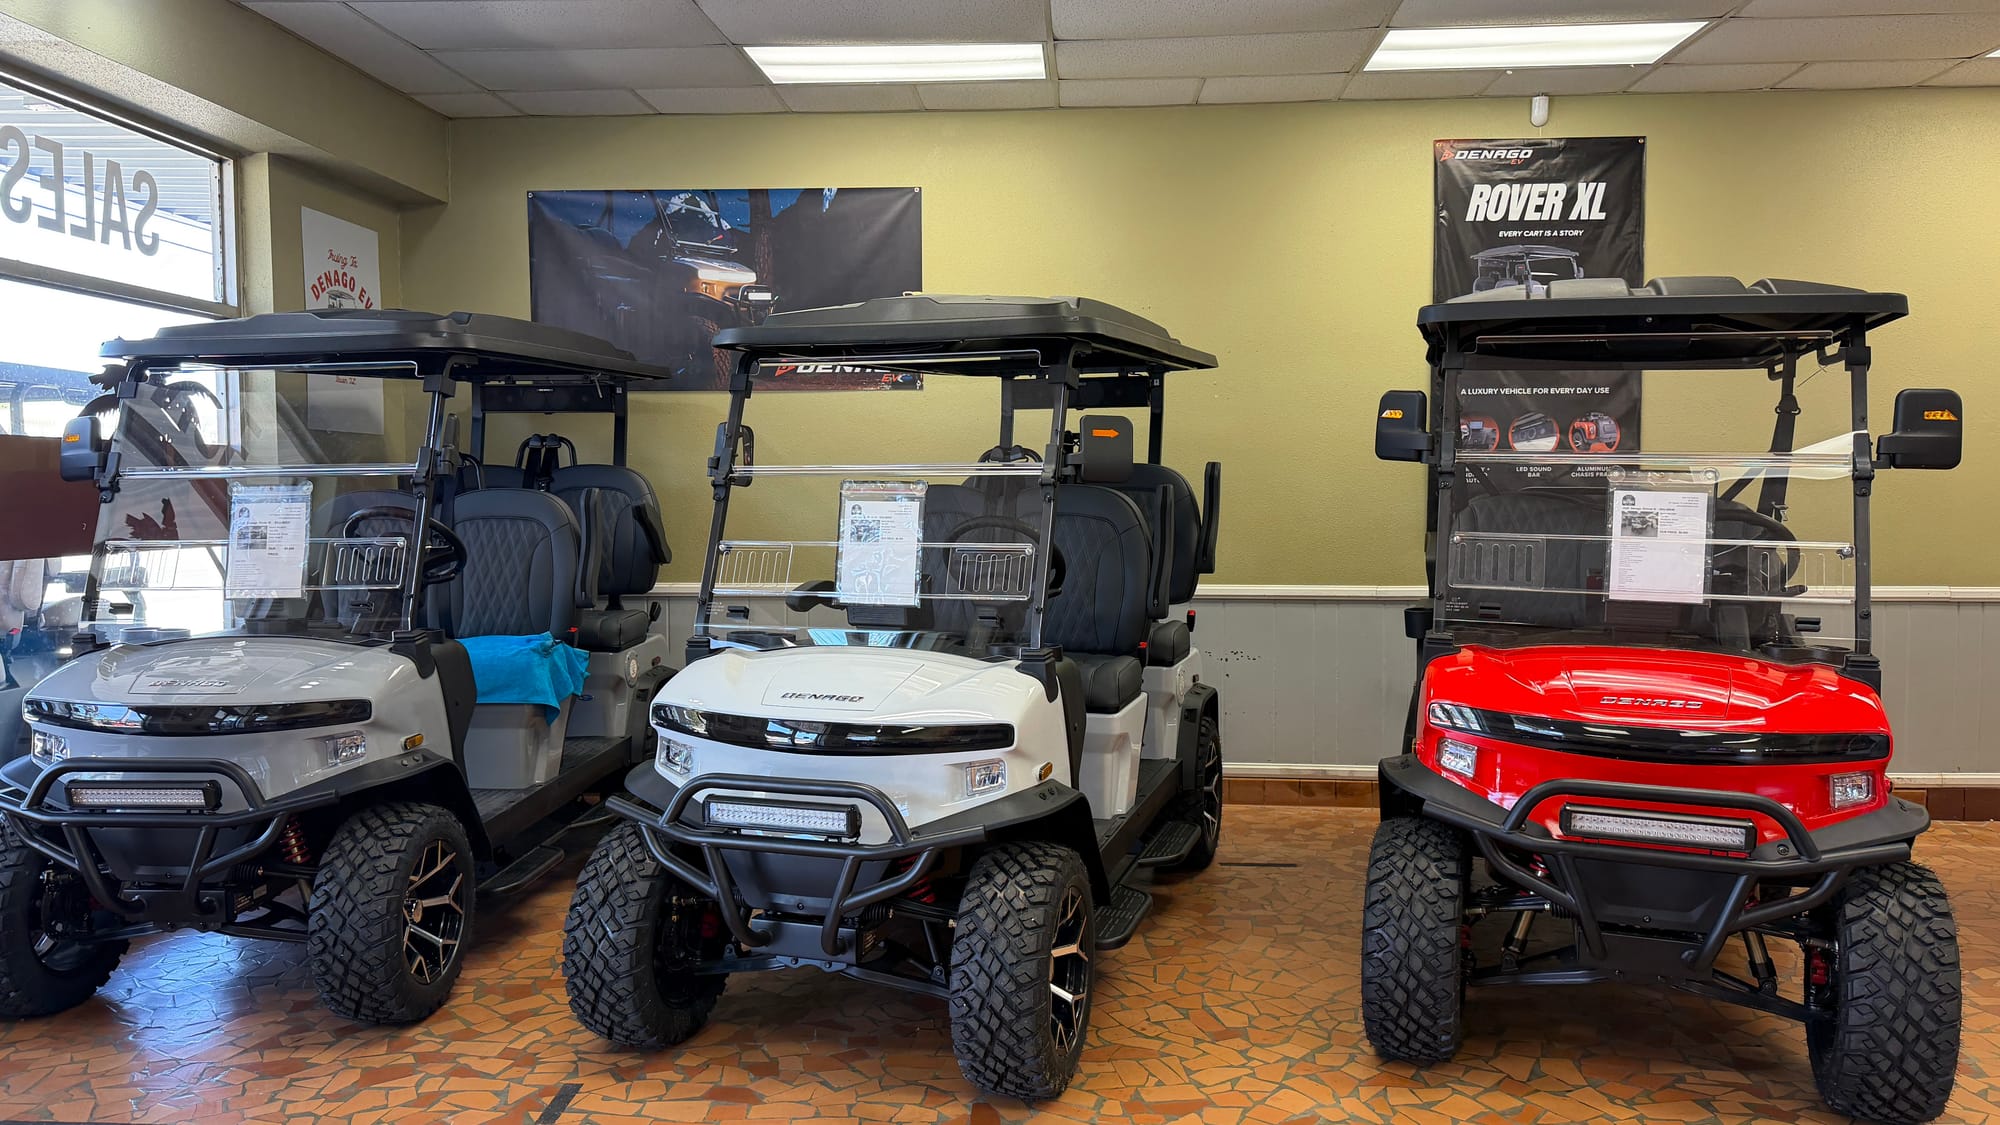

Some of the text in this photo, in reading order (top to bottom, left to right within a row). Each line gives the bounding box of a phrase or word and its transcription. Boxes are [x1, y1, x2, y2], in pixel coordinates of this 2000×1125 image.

[1454, 149, 1534, 160] DENAGO
[1465, 182, 1607, 222] ROVER XL
[1559, 229, 1584, 237] STORY
[310, 269, 374, 310] DENAGO EV
[781, 692, 864, 702] DENAGO
[1600, 696, 1703, 709] DENAGO
